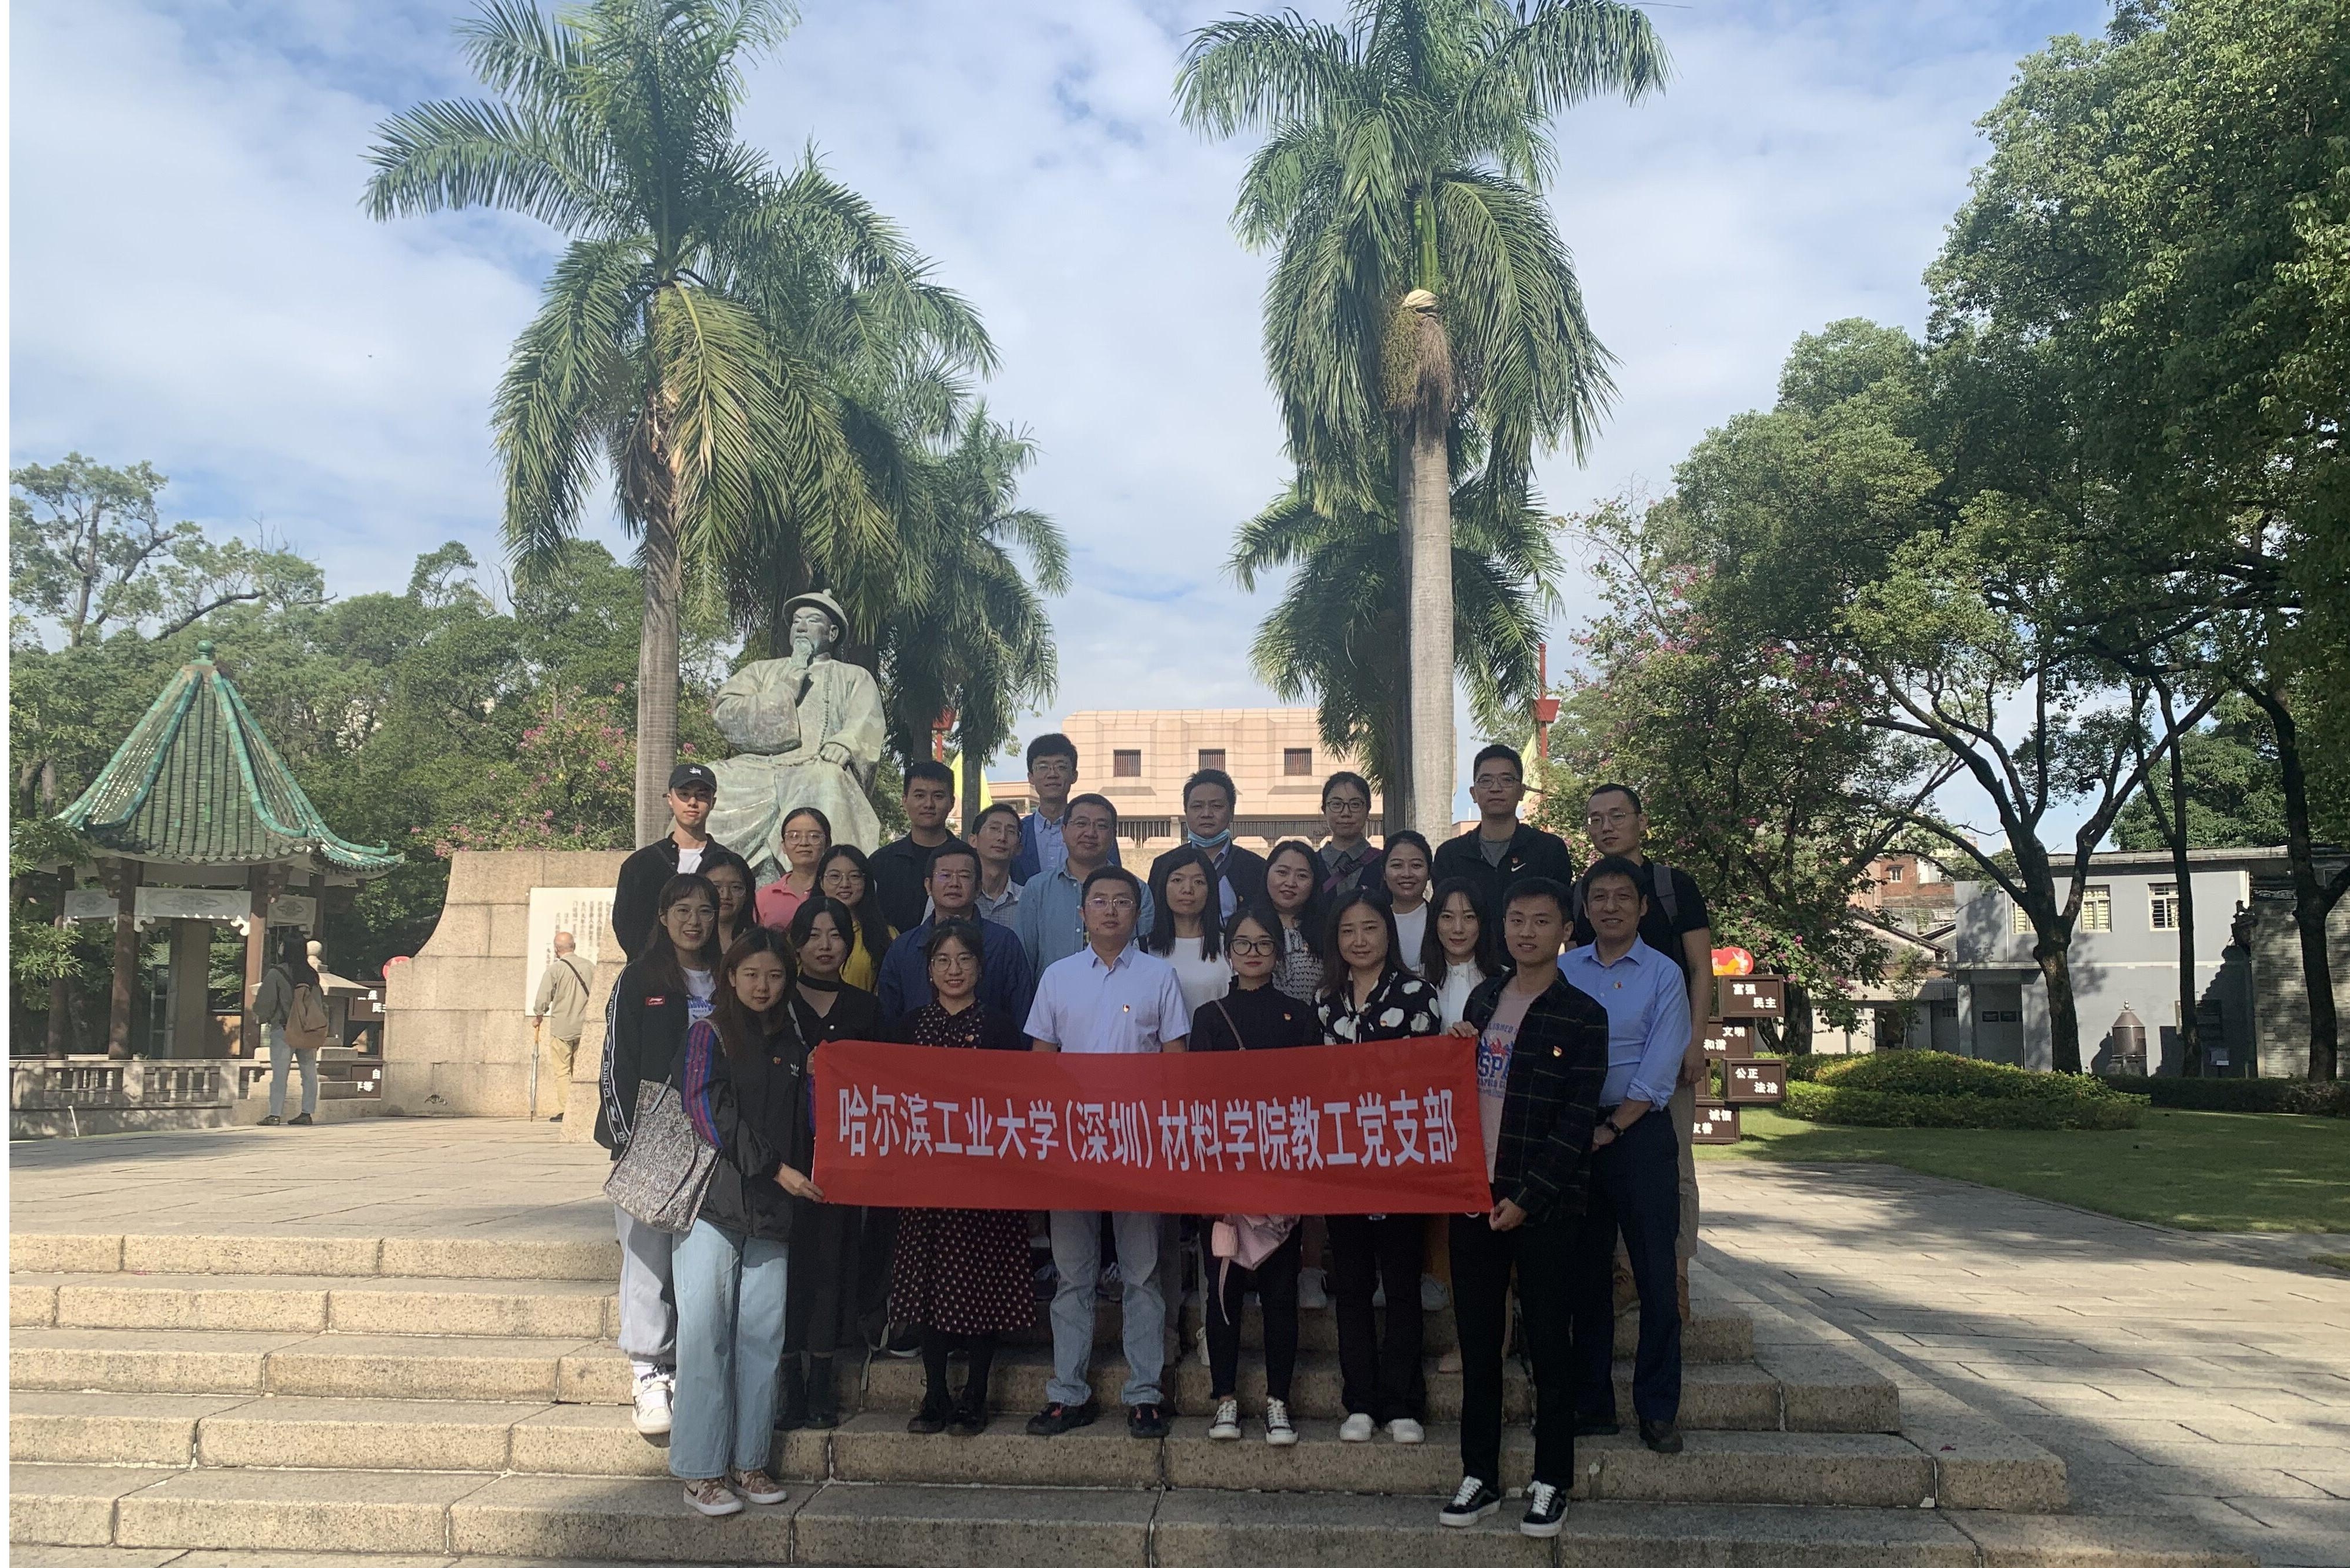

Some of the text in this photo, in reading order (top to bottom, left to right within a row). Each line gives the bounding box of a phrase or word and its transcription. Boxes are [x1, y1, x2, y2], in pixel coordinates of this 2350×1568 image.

[1733, 984, 1756, 995] 富强
[1753, 997, 1777, 1009] 民主
[1722, 1026, 1746, 1037] 文明
[1703, 1038, 1726, 1051] 和谐
[1735, 1068, 1758, 1079] 公正
[1754, 1082, 1778, 1094] 法治
[1708, 1109, 1732, 1122] 诚信
